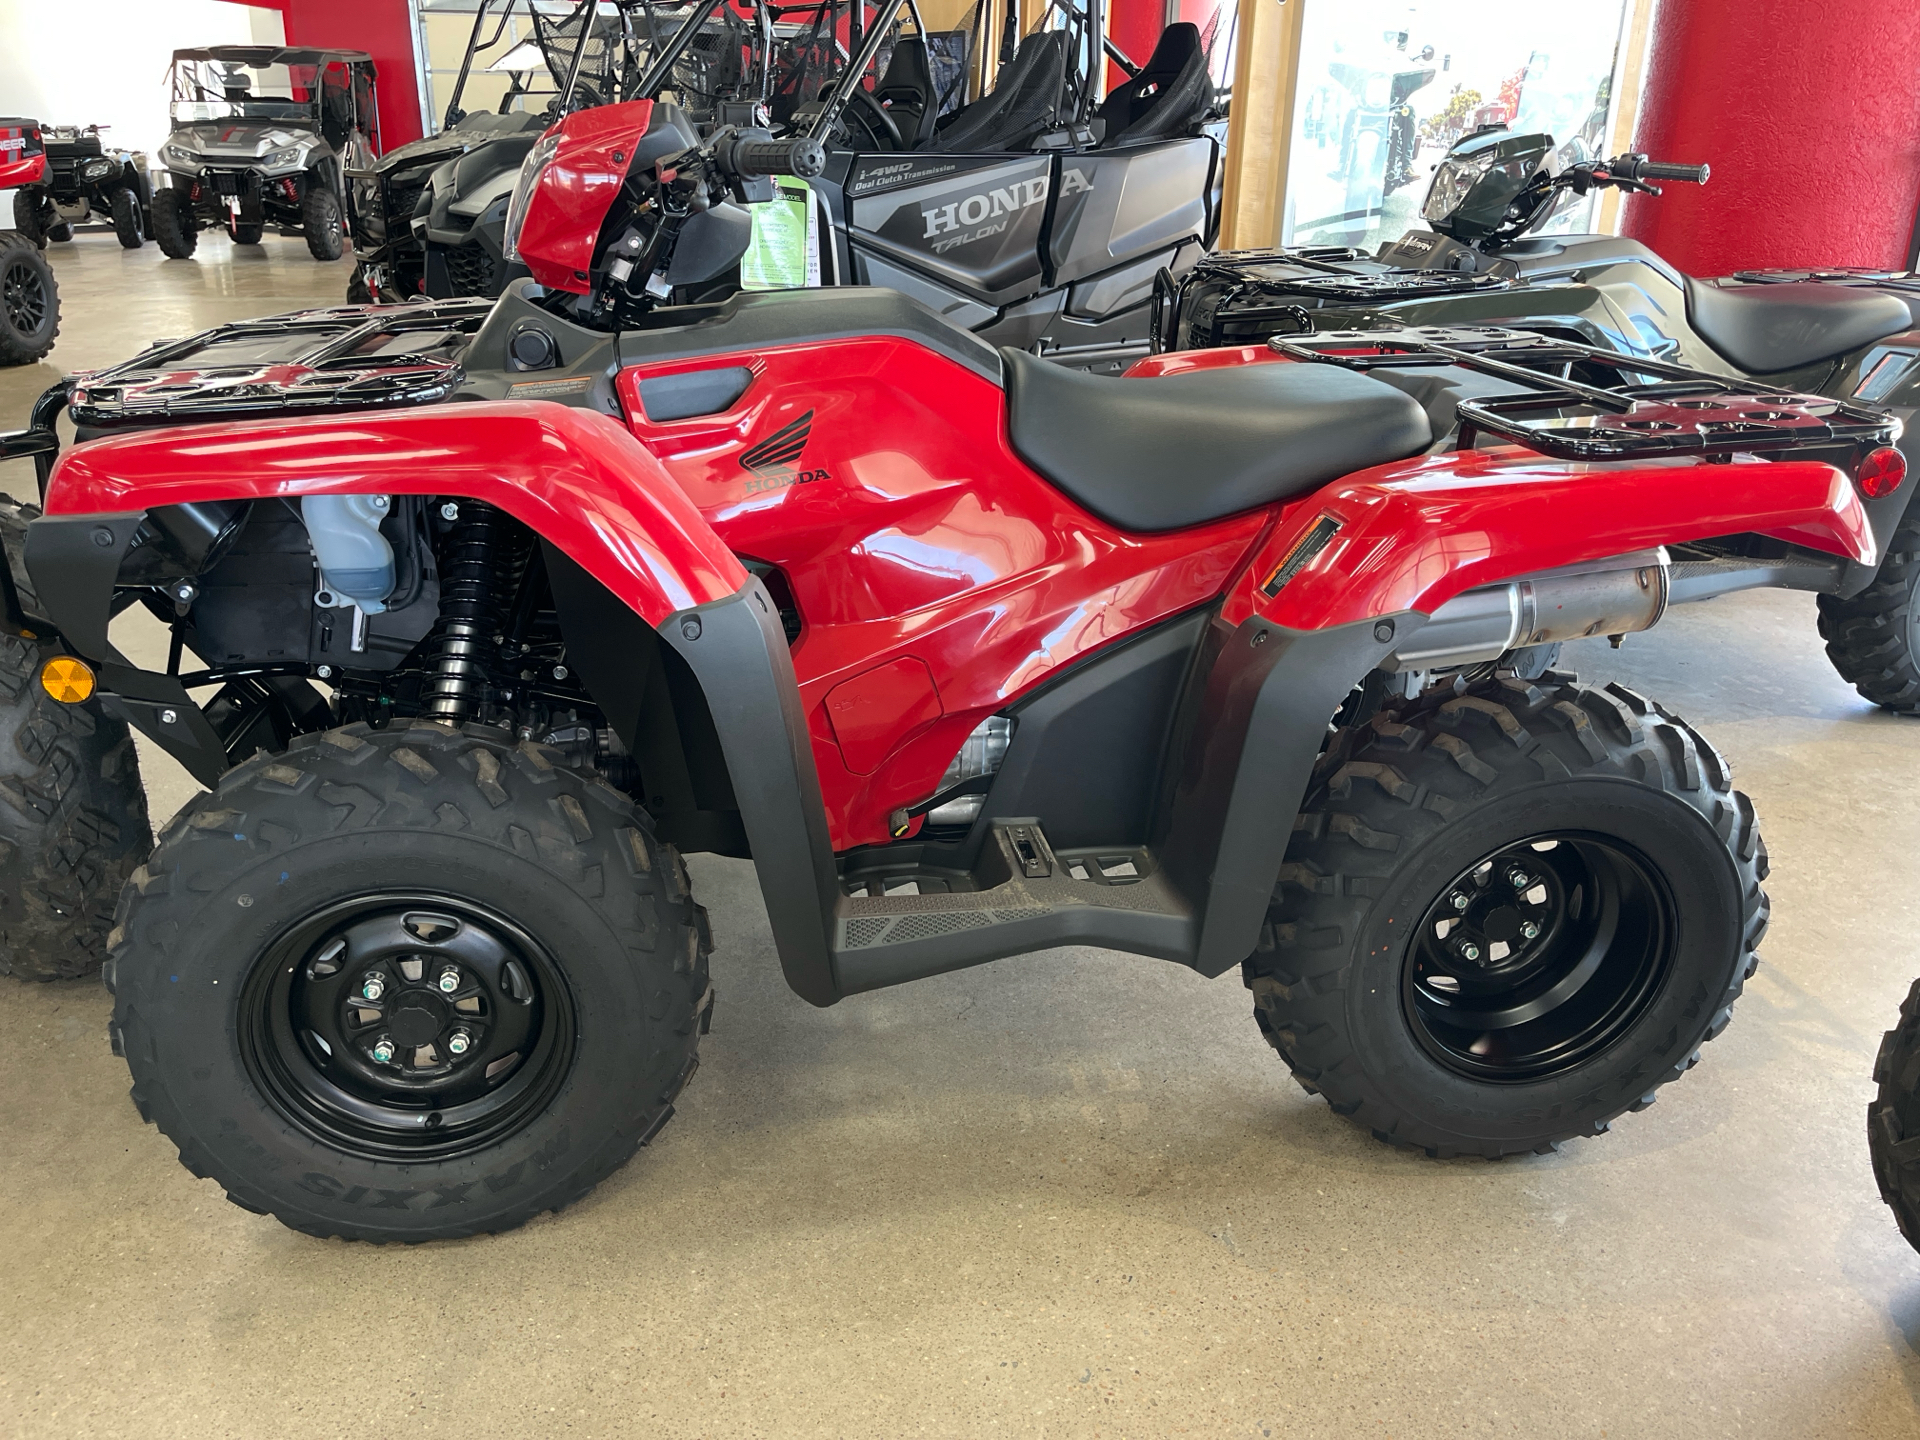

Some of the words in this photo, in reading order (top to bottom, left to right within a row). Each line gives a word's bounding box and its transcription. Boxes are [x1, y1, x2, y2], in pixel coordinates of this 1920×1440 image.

[854, 180, 875, 191] Dual
[876, 174, 903, 186] Clutch
[903, 164, 956, 180] Transmission
[859, 162, 914, 180] i-4WD
[921, 168, 1095, 239] HONDA
[931, 220, 1008, 254] TALON
[744, 468, 832, 493] HONDA
[295, 1126, 572, 1211] MAXXIS
